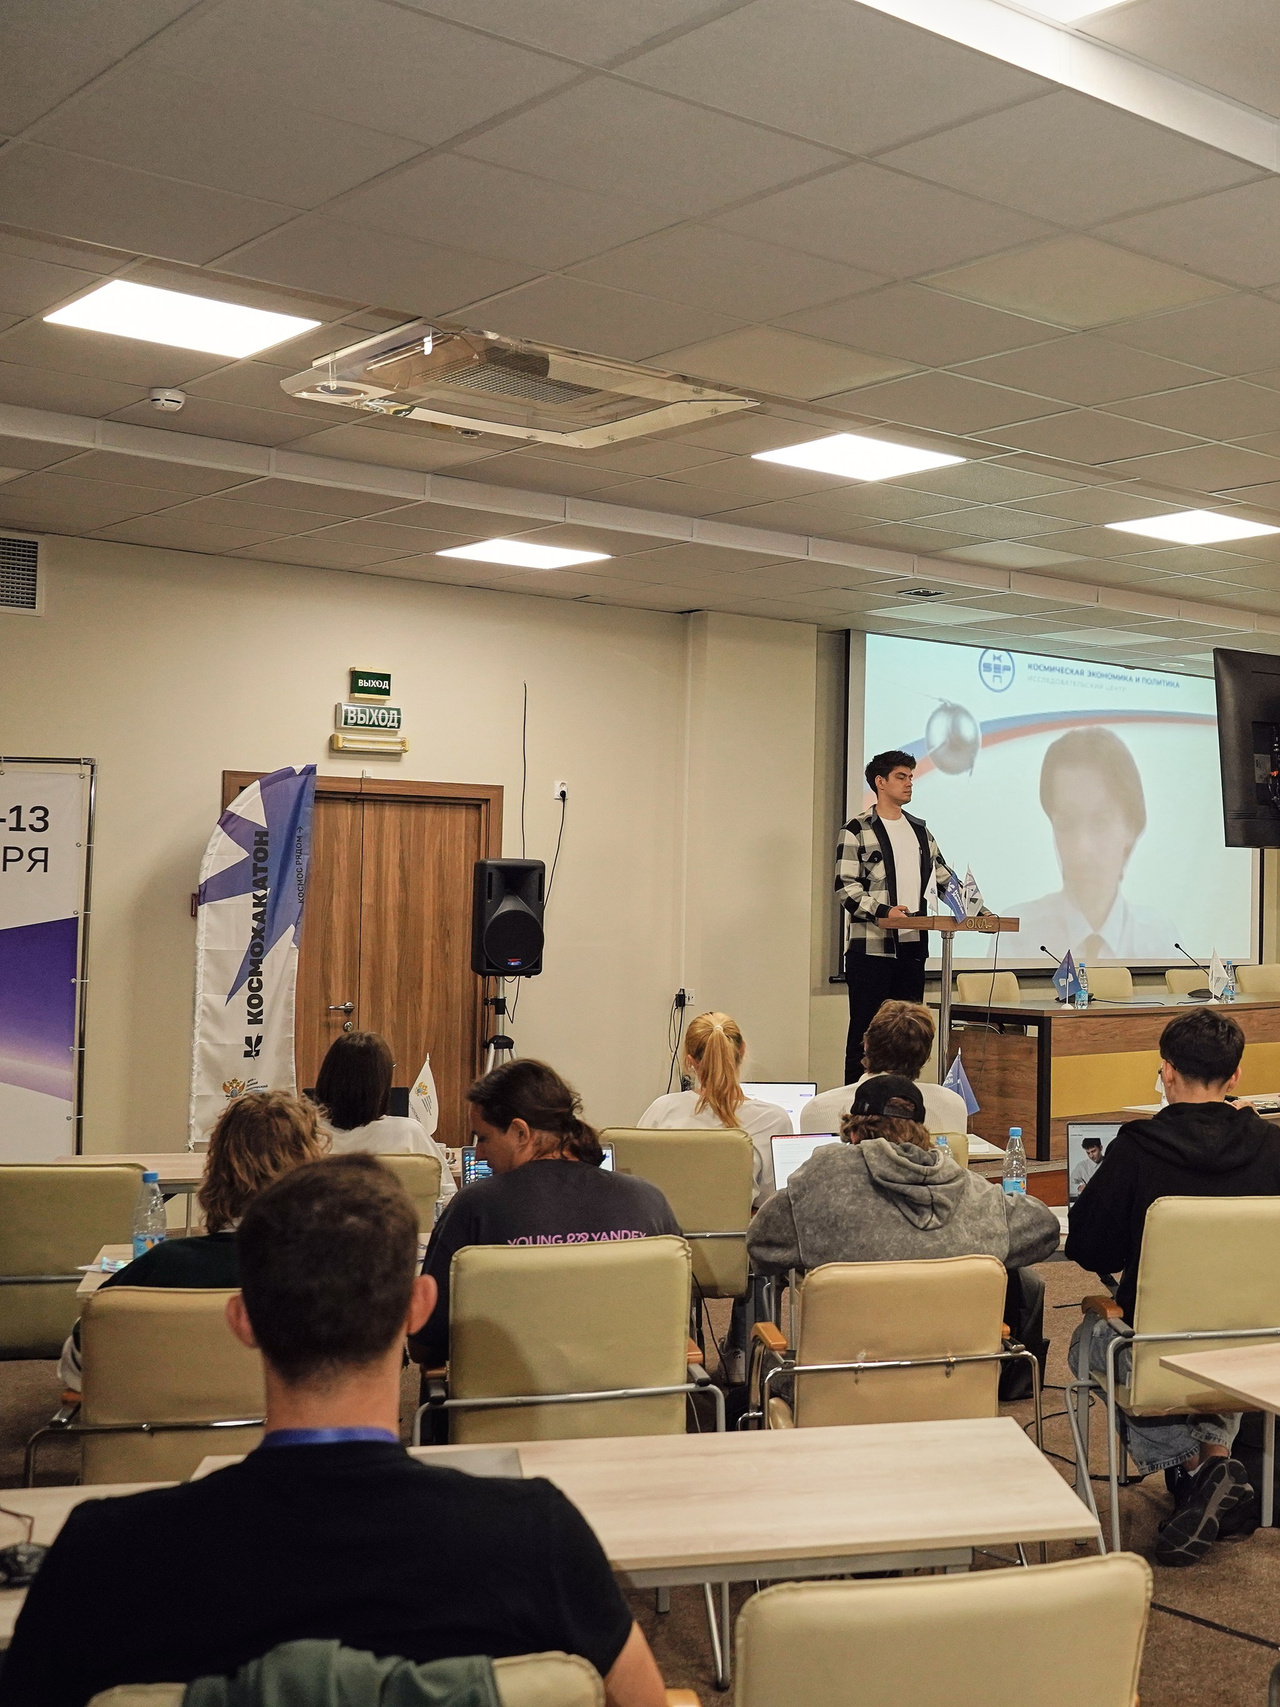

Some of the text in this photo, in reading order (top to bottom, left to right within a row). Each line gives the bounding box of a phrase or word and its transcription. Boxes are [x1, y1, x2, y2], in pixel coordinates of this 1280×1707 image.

[358, 679, 390, 690] ВЫХОД
[1027, 663, 1085, 676] КОСМИЧЕСКАЯ
[1087, 670, 1133, 683] ЭКОНОМИКА
[1142, 677, 1180, 688] ПОЛИТИКА
[347, 708, 398, 728] ВЫХОД
[295, 835, 305, 904] КОСМОС РЯДОМ
[247, 830, 269, 1025] КОСМОХАКАТОН
